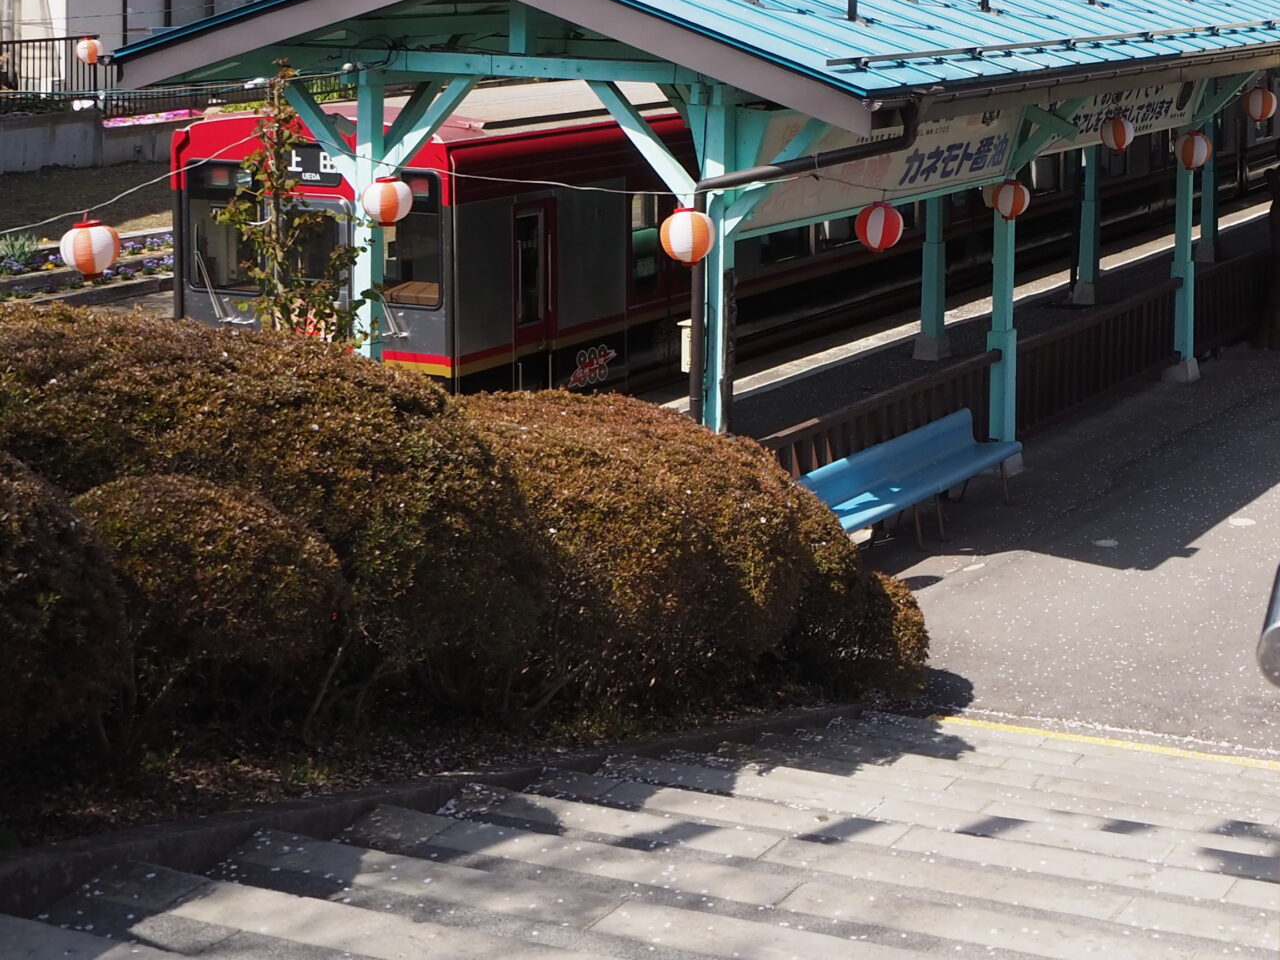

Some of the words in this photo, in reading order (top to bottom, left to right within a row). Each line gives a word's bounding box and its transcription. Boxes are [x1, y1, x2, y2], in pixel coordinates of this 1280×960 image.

[287, 149, 338, 173] 上田
[899, 132, 1010, 186] カネモト醤油
[302, 172, 321, 181] UEDA
